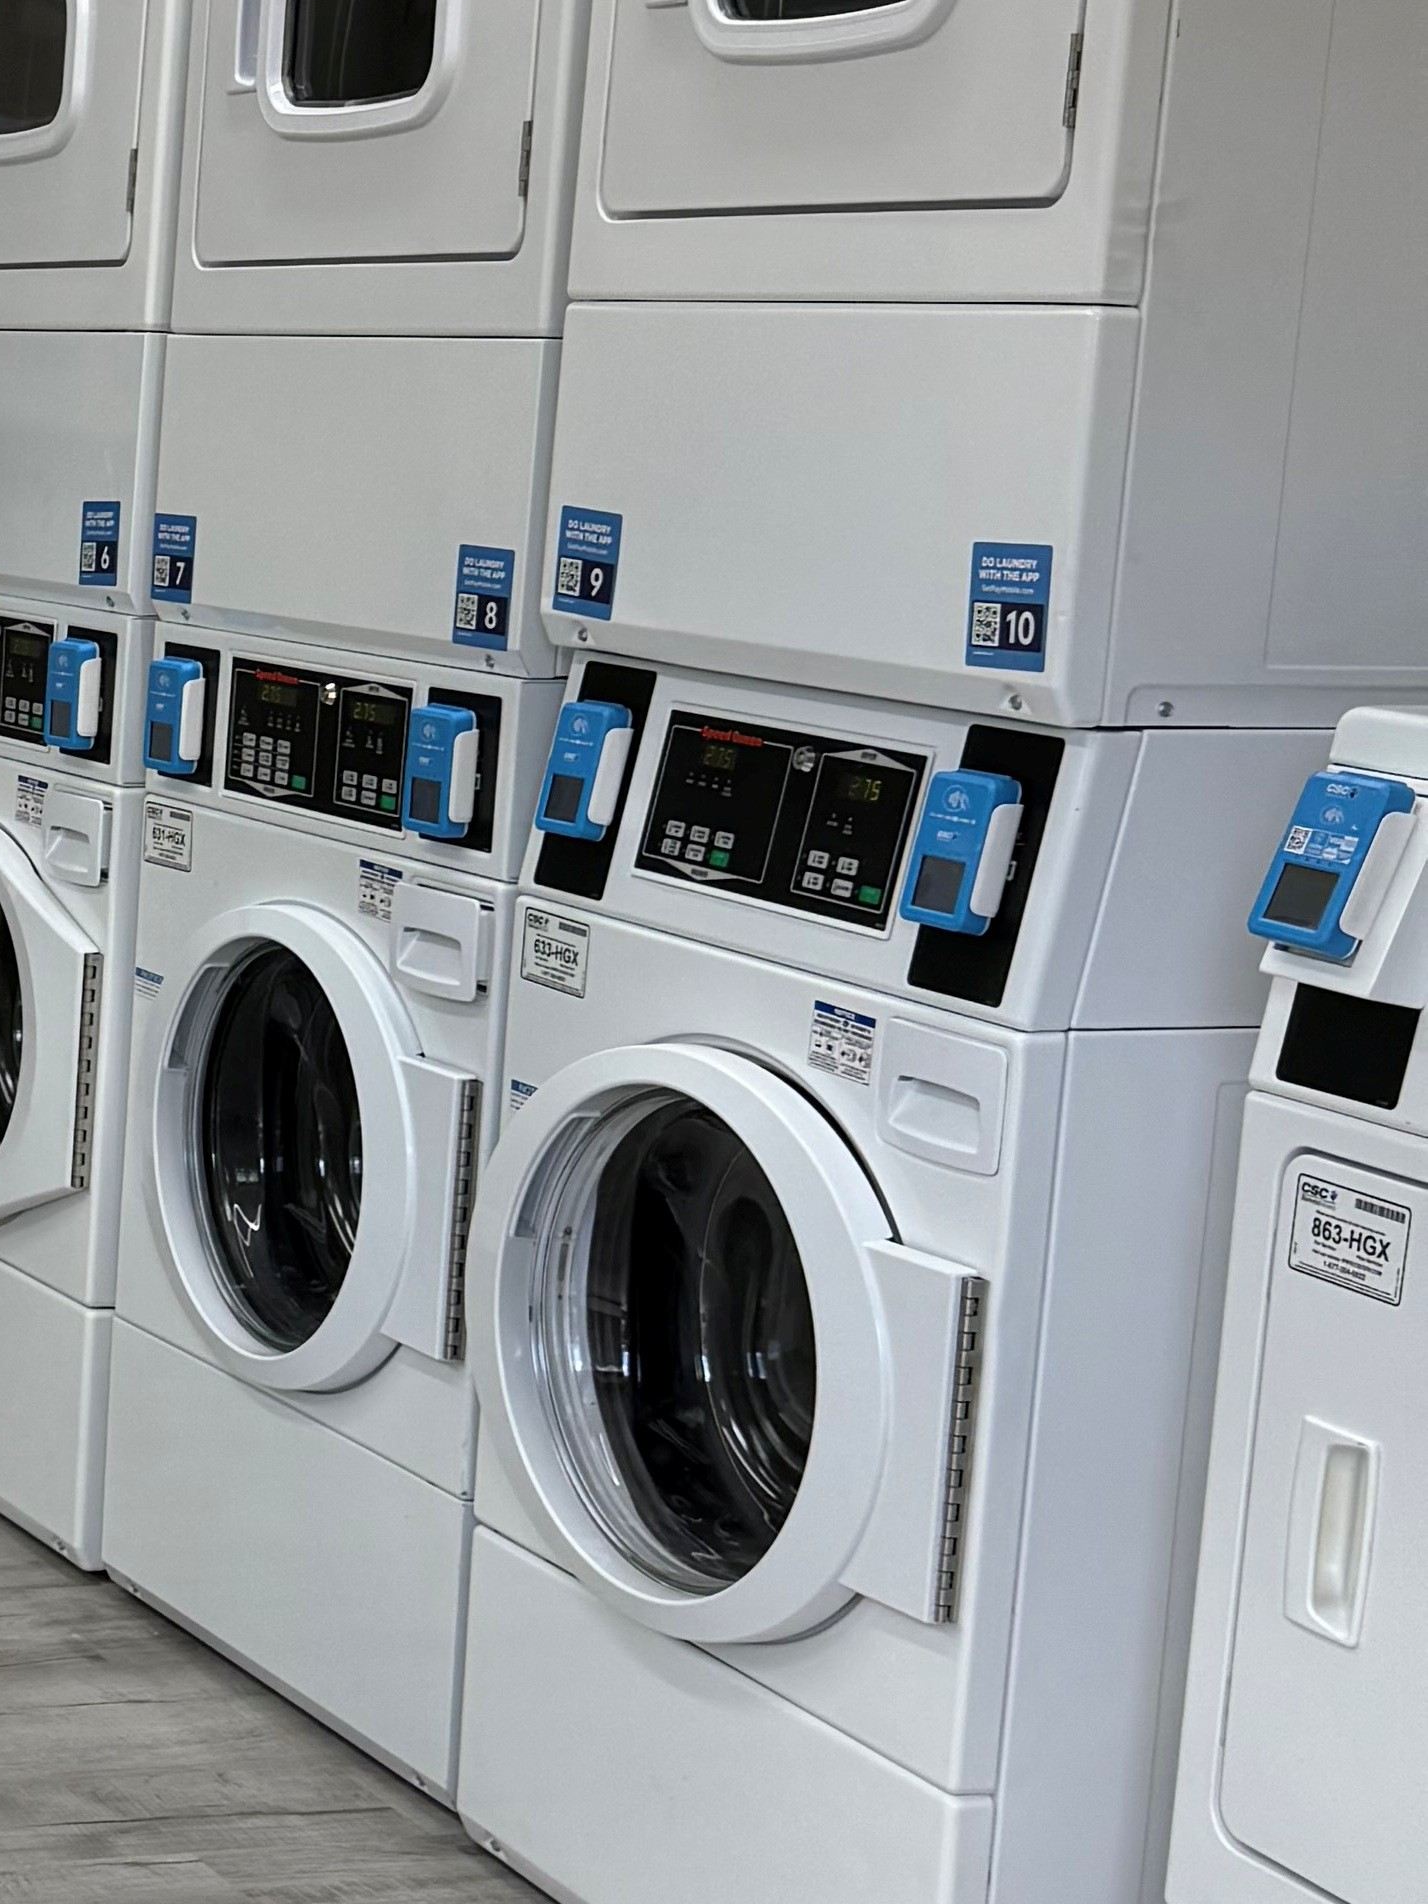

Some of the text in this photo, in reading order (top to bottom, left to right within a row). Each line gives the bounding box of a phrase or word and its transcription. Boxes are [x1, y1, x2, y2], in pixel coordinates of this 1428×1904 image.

[579, 521, 612, 534] LAUNDRY
[598, 535, 613, 545] APP
[100, 545, 110, 570] 6
[981, 556, 1038, 570] DO LAUNDRY
[175, 561, 186, 585] 7
[590, 567, 604, 597] 9
[978, 569, 1040, 583] WITH THE APP
[484, 601, 497, 629] 8
[1006, 610, 1035, 646] 10
[534, 938, 580, 967] 633-HGX
[1301, 1181, 1330, 1199] CSC
[1311, 1217, 1391, 1262] 863-HGX
